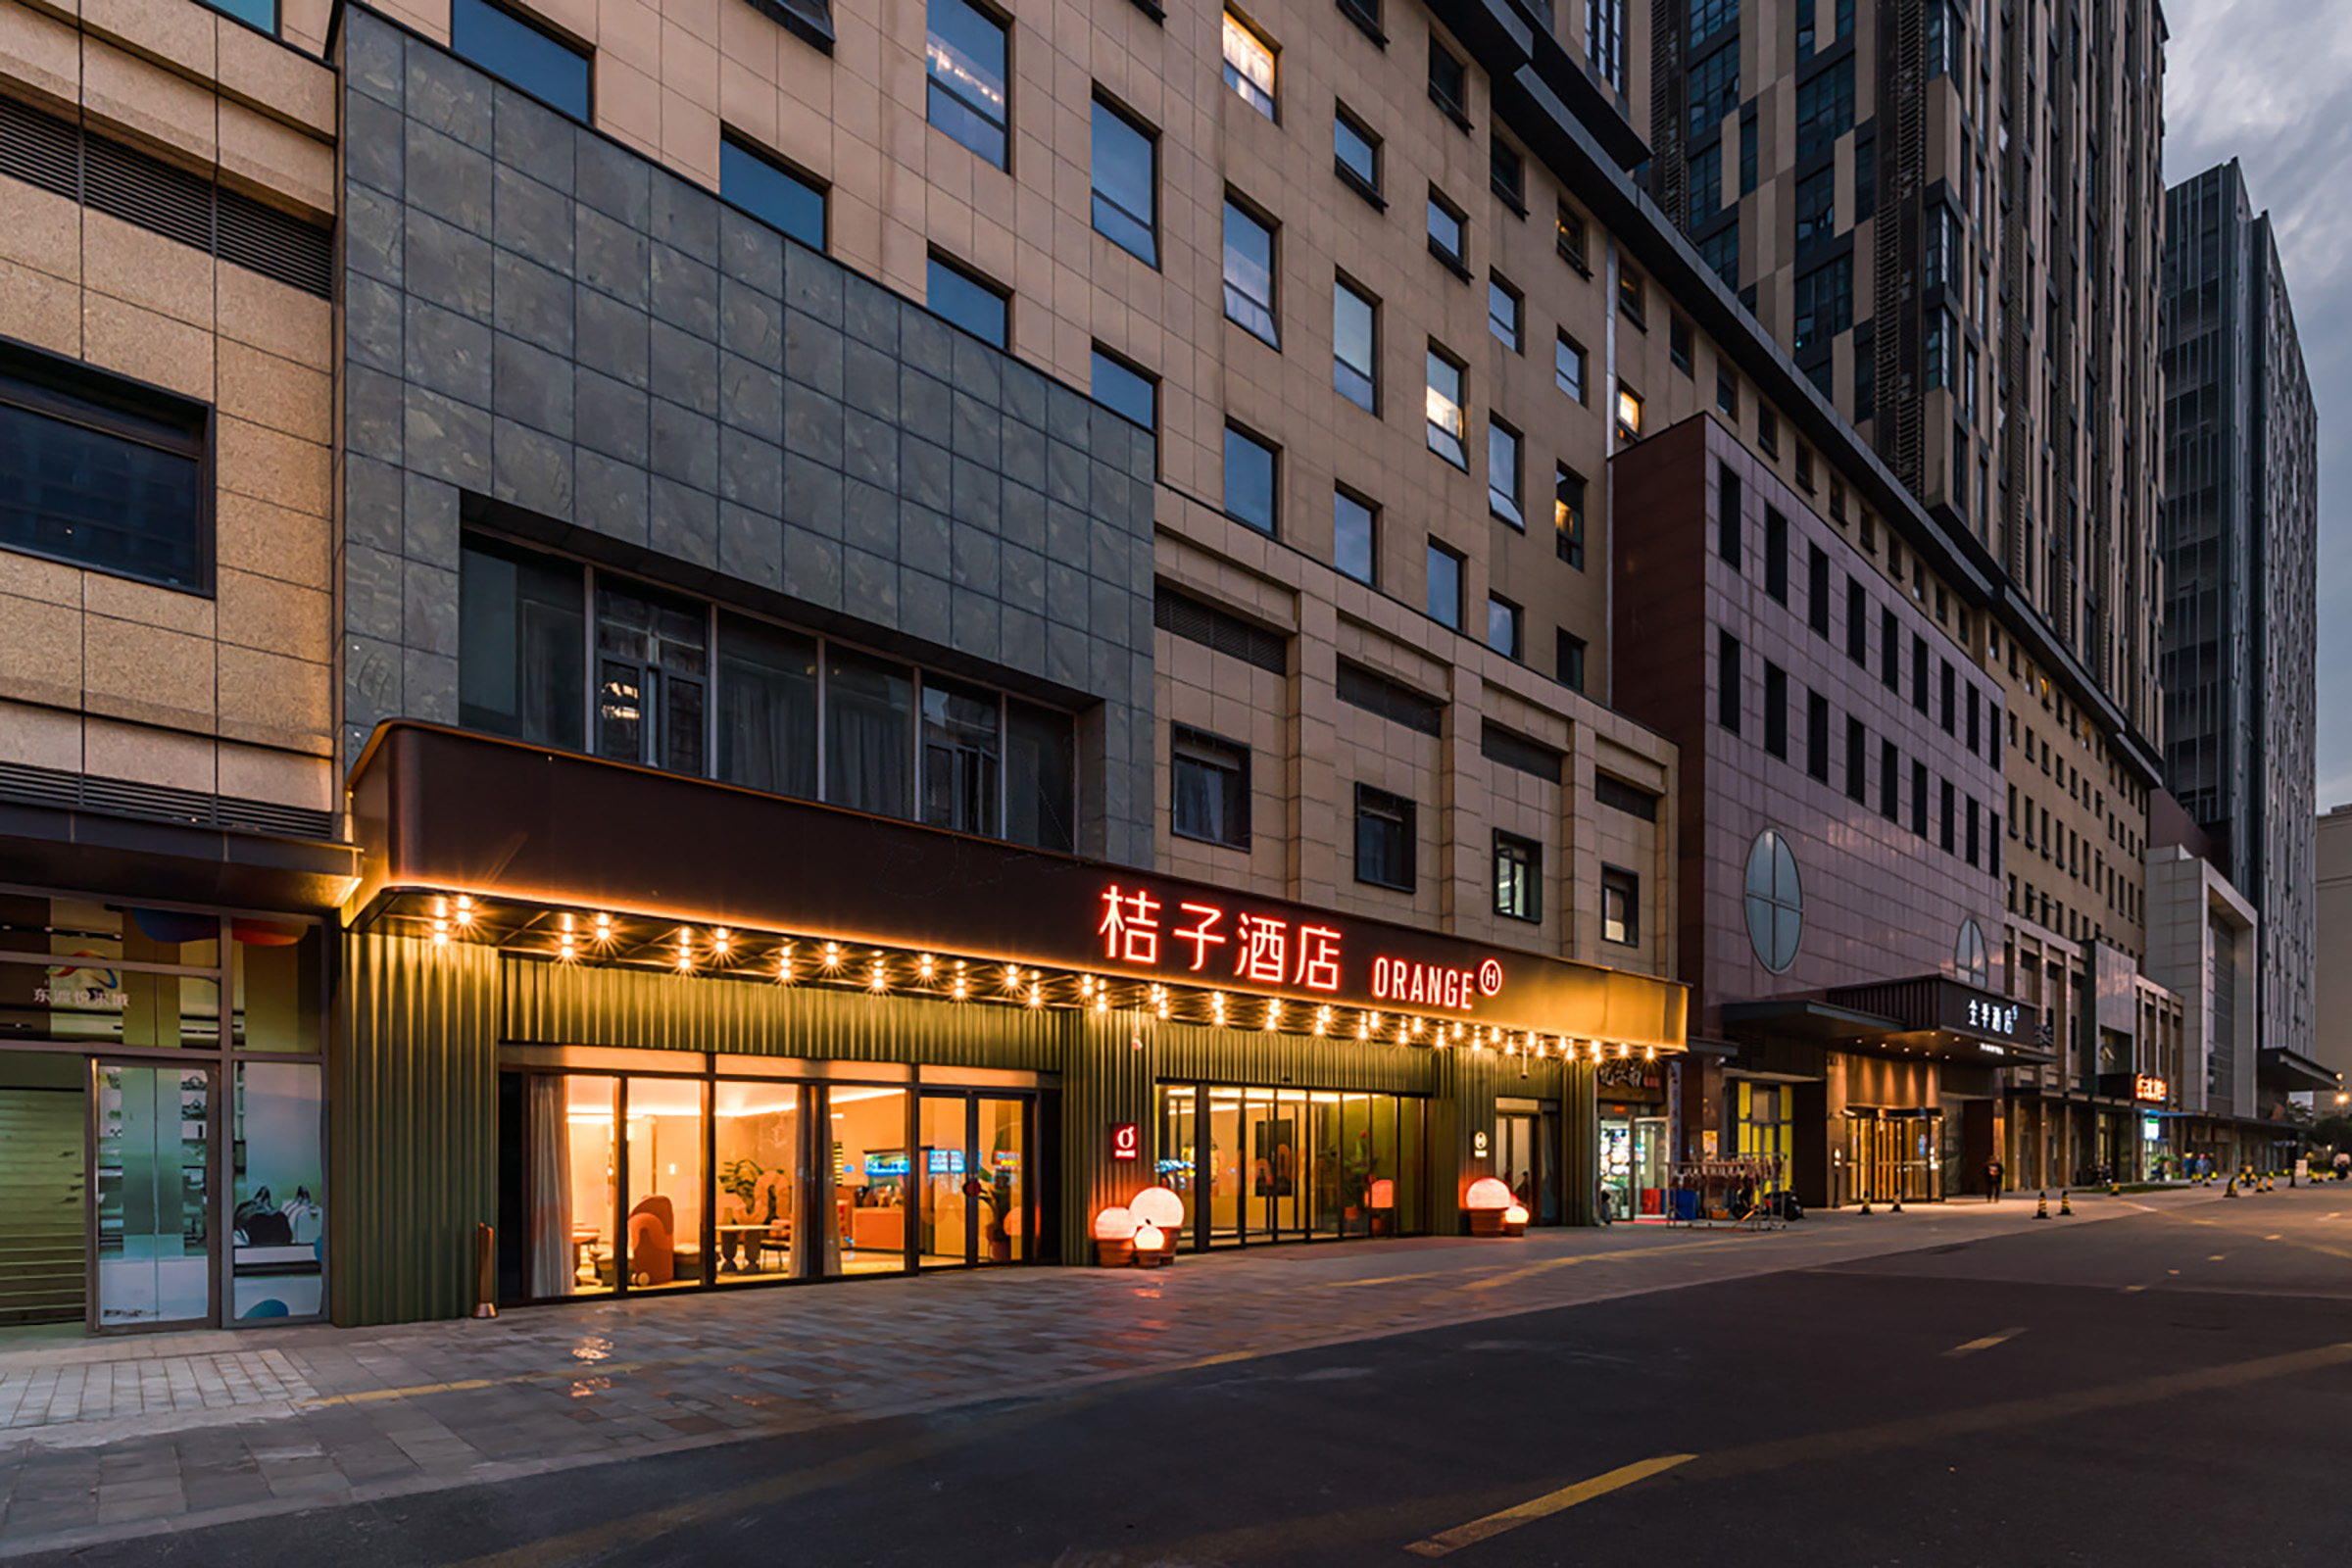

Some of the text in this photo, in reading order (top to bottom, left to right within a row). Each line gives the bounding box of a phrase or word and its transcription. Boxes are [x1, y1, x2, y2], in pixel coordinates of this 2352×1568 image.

[1098, 884, 1343, 991] 桔子酒店
[1373, 956, 1474, 1010] ORANGE
